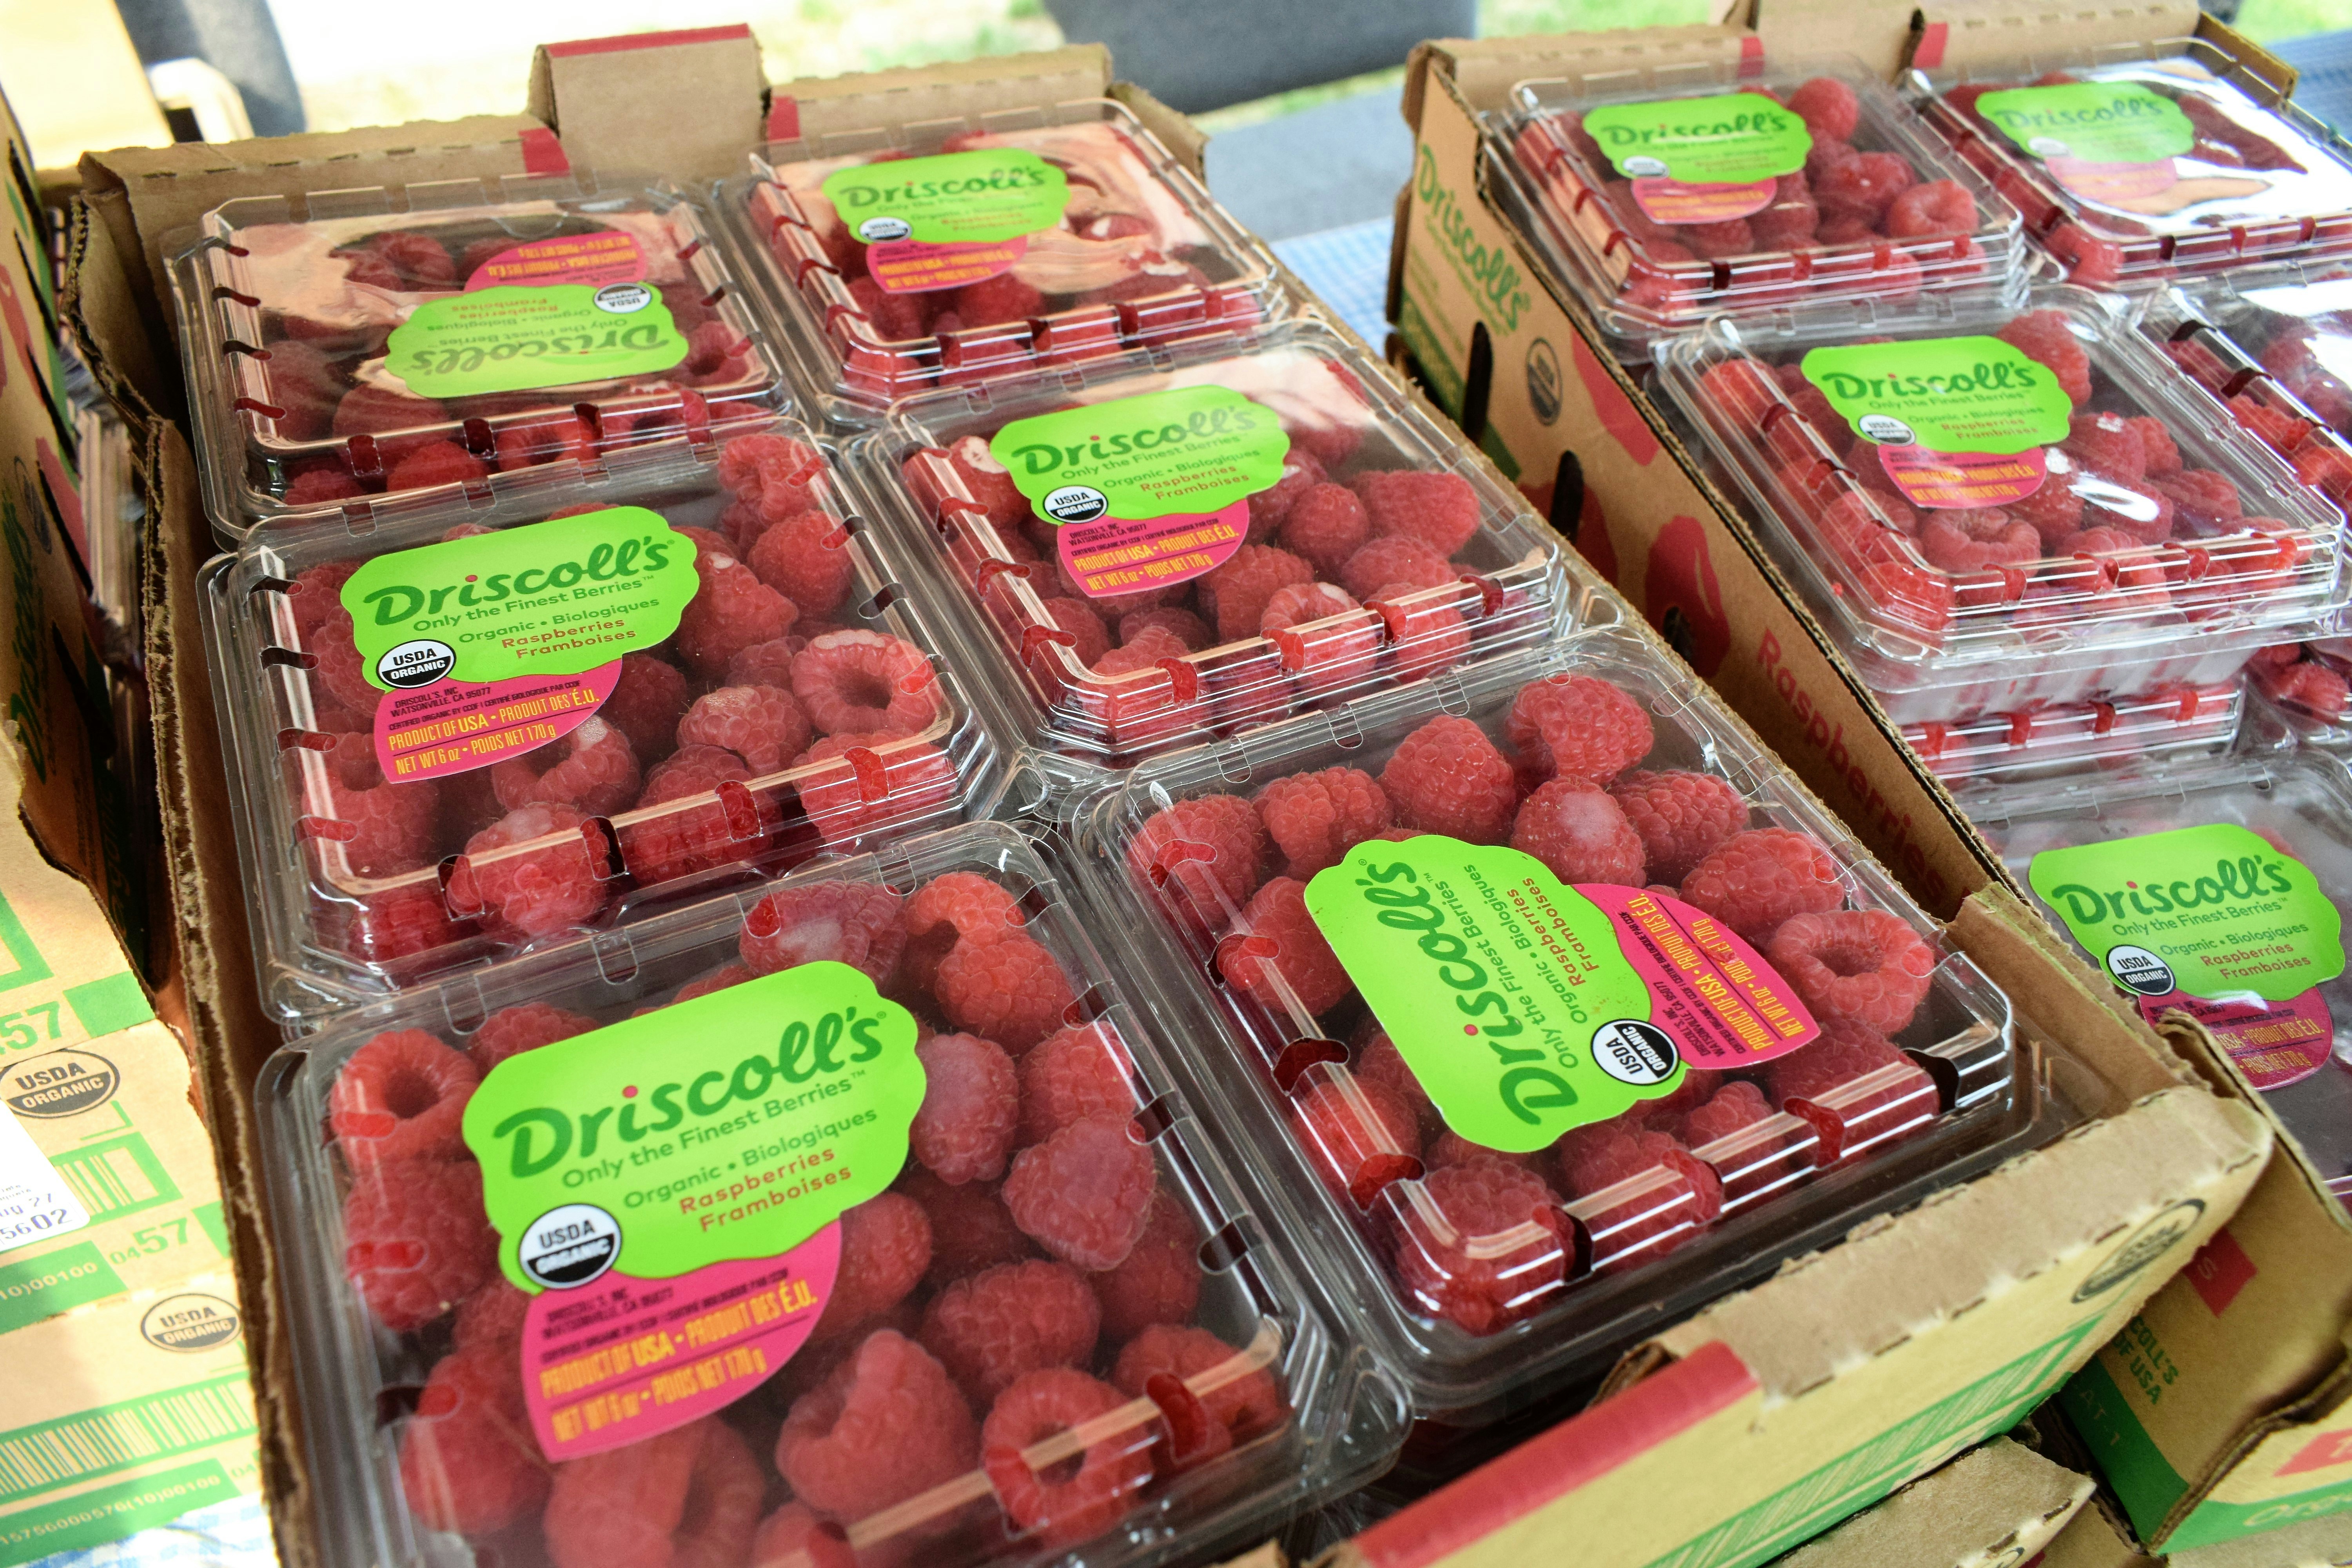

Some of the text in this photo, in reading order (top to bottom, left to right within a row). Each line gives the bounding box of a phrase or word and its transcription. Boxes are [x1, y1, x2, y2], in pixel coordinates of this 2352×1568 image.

[1996, 98, 2163, 128] Driscoll's
[415, 324, 670, 377] Driscoll's
[1821, 361, 2038, 400] Driscoll's
[1013, 403, 1256, 475] Driscoll's
[1062, 437, 1241, 479] Only the Finest Berries
[1103, 450, 1261, 487] Organic Biologiques
[1140, 467, 1237, 491] Raspberries
[1154, 475, 1250, 499] Framboises
[1055, 492, 1090, 506] USDA
[1058, 501, 1100, 516] ORGANIC
[1074, 525, 1239, 572] PRODUCT OF USA PRODUIT DES É.U.
[1087, 554, 1213, 590] NET WT 6 oz POIDS NET 170 g
[413, 615, 461, 631] Only
[466, 608, 500, 620] the
[505, 593, 569, 612] Finest
[459, 599, 659, 643] Organic Biologiques
[502, 620, 624, 648] Raspberries
[516, 631, 635, 659] Framboises
[391, 660, 445, 679] ORGANIC
[393, 648, 437, 666] USDA
[389, 689, 599, 750] PRODUCT OF USA PRODUIT DES É.U.
[396, 724, 556, 775] NET WT 6 oz POIDS NET 170 g
[1758, 628, 1945, 907] Raspberries
[2053, 853, 2294, 926] Driscoll's
[1508, 889, 1585, 986] Raspberries
[1524, 878, 1598, 971] Framboises
[2112, 922, 2148, 936] Only
[2149, 919, 2178, 930] the
[2176, 911, 2229, 926] Finest
[2160, 925, 2310, 955] Organic Biologiques
[1464, 865, 1588, 1024] Organic Biologiques
[2118, 956, 2153, 970] USDA
[2200, 944, 2295, 965] Raspberries
[1477, 939, 1523, 993] Finest
[1629, 893, 1773, 1050] PRODUCT OF USA PRODUIT DES É.U.
[1692, 918, 1805, 1036] NET WT 6 oz POID ET 170 g
[2126, 969, 2167, 984] ORGANIC
[2218, 959, 2313, 978] Framboises
[1519, 995, 1546, 1025] the
[2294, 1016, 2325, 1035] É.U.
[1541, 1029, 1579, 1069] Only
[1606, 1036, 1644, 1074] USDA
[1622, 1026, 1667, 1071] ORGANIC
[15, 1063, 86, 1090] USDA
[22, 1077, 104, 1108] ORGANIC
[563, 1158, 623, 1189] Only
[629, 1143, 673, 1166] the
[679, 1112, 760, 1148] Finest
[624, 1111, 877, 1208] Organic Biologiques
[679, 1150, 835, 1213] Raspberries
[699, 1170, 851, 1230] Framboises
[110, 1217, 188, 1265] 0457
[539, 1218, 596, 1251] USDA
[160, 1307, 216, 1327] USDA
[163, 1319, 232, 1344] ORGANIC
[632, 1333, 673, 1366] USA
[2129, 1356, 2161, 1405] USA
